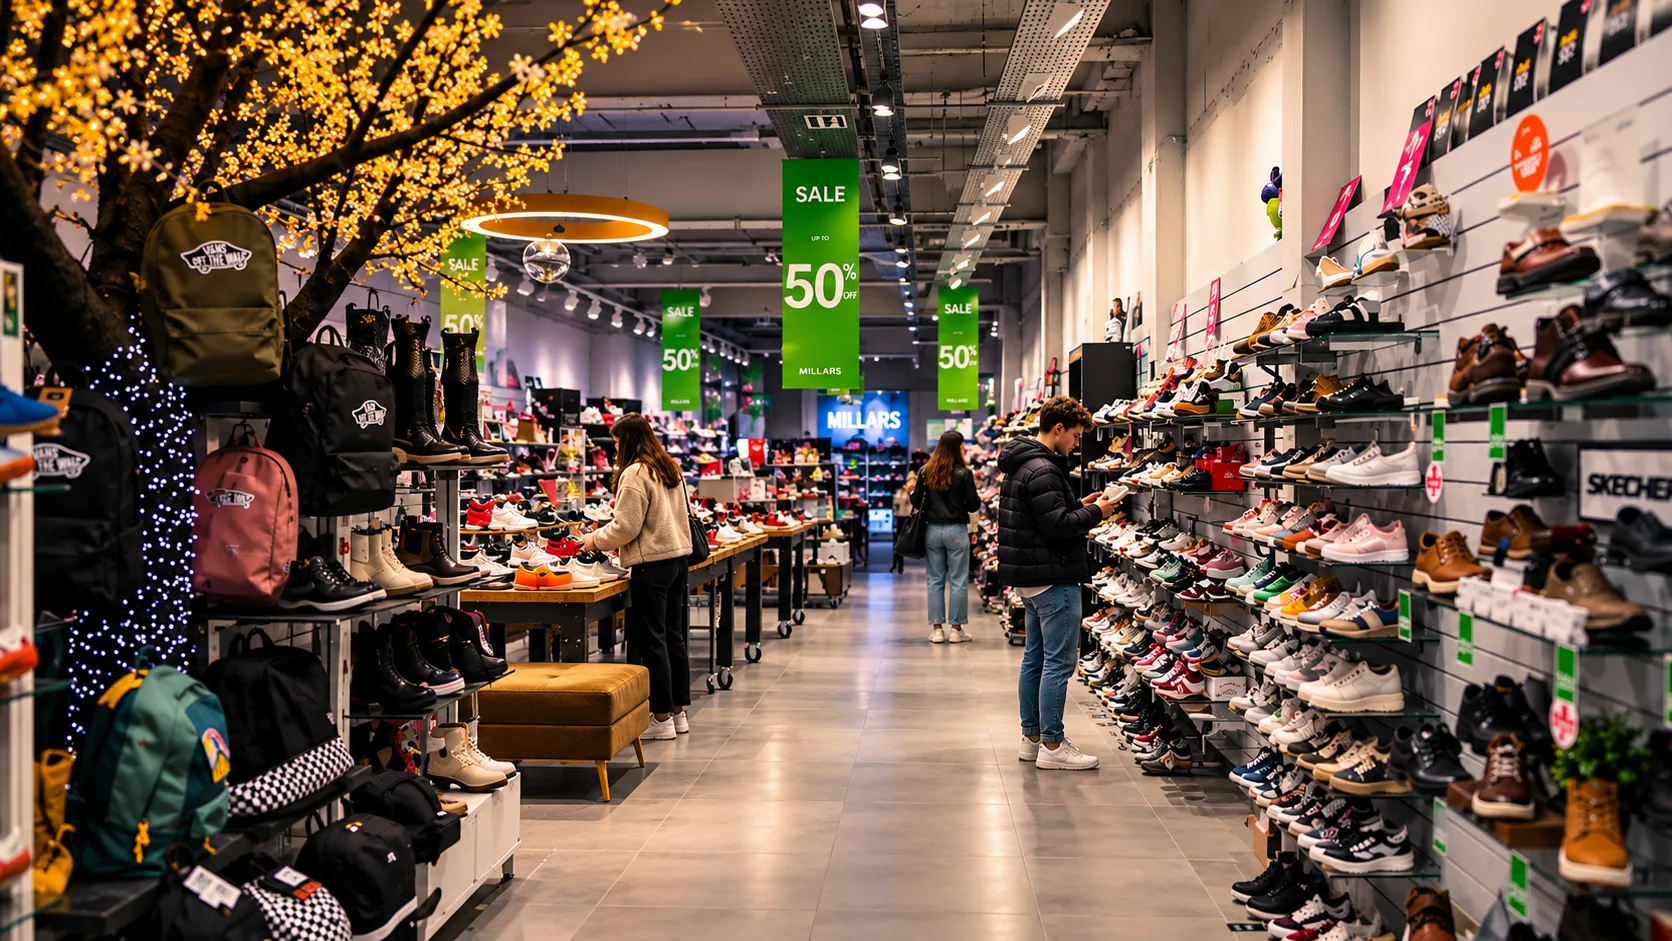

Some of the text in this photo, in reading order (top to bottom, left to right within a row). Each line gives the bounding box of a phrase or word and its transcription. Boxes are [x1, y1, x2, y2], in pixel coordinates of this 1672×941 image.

[795, 186, 846, 203] SALE
[448, 258, 479, 272] SALE
[784, 263, 857, 309] 50%
[843, 291, 857, 300] OFF
[667, 306, 694, 318] SALE
[944, 303, 972, 315] SALE
[662, 348, 699, 372] 50%
[938, 344, 977, 369] 50%
[799, 367, 841, 375] MILLARS
[827, 411, 901, 429] MILLARS
[1587, 472, 1672, 502] SKECHE
